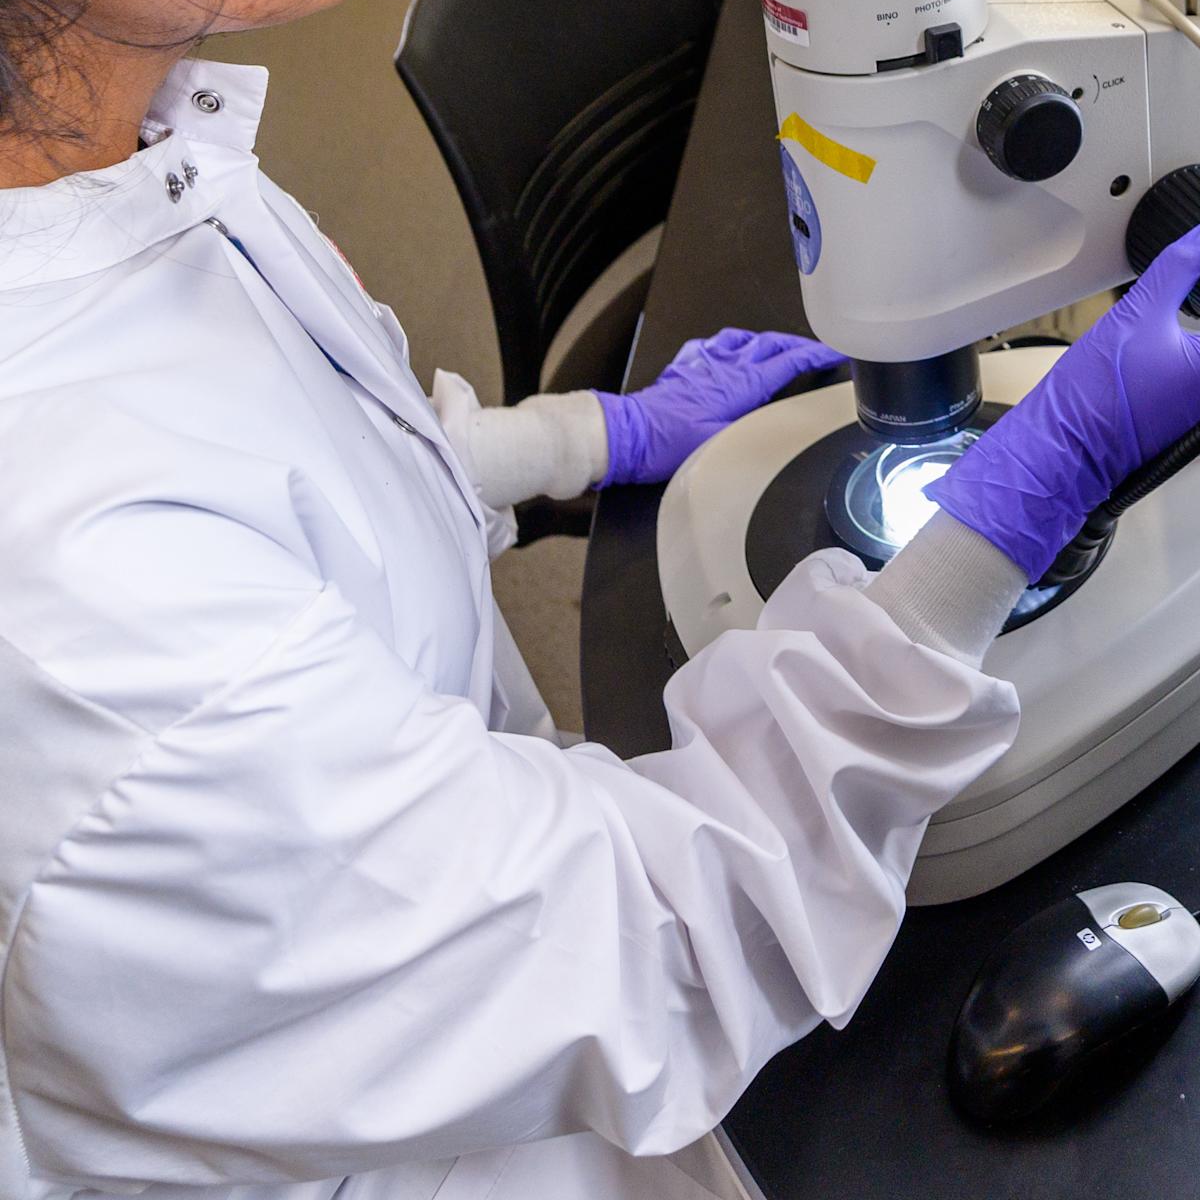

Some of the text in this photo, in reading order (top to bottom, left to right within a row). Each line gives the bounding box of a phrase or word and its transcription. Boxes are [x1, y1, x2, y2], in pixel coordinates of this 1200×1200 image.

[876, 11, 899, 21] BINO
[1102, 76, 1126, 89] CLICK
[880, 413, 907, 423] JAPAN
